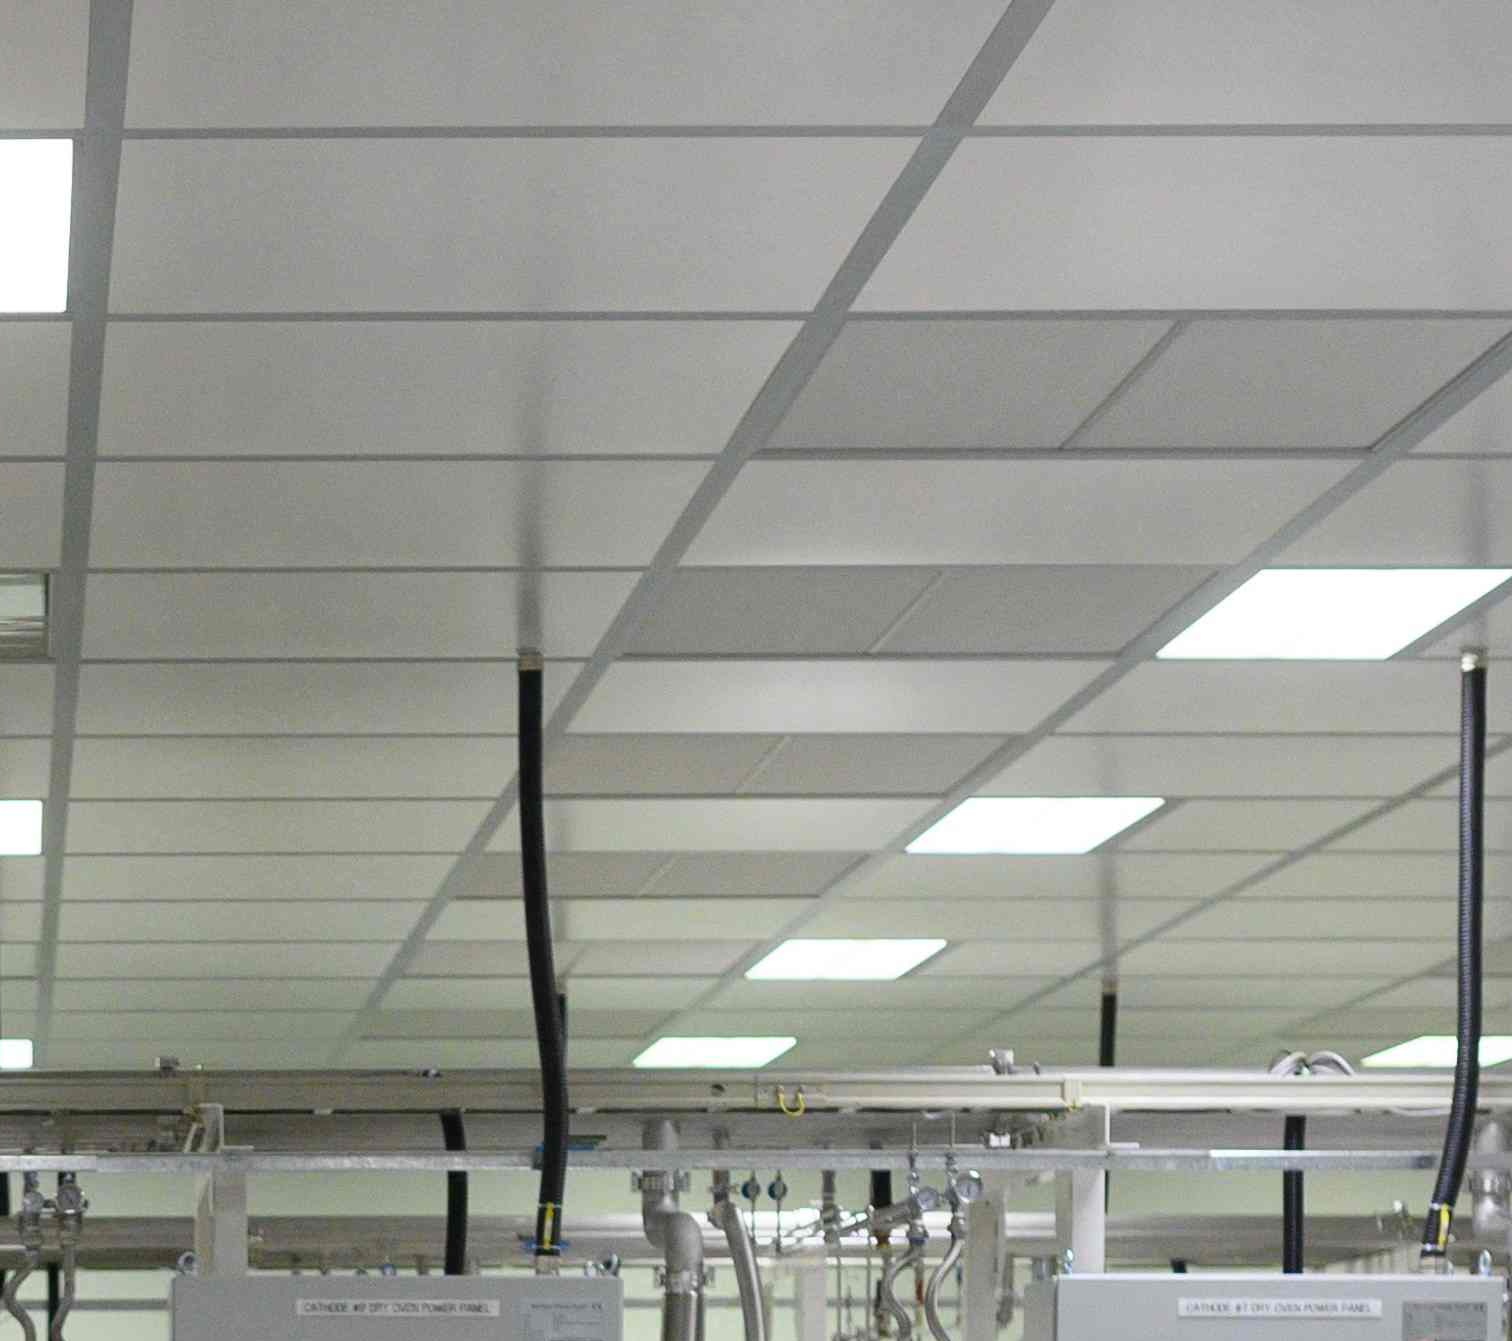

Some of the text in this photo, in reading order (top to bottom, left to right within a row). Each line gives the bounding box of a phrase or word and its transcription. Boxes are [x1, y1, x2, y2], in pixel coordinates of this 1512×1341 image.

[303, 1302, 348, 1313] CATHODE
[369, 1302, 389, 1313] DRY
[393, 1302, 420, 1313] OVEN
[422, 1302, 457, 1313] POWER
[459, 1302, 490, 1313] PANEL
[1186, 1303, 1229, 1313] CATHODE
[1274, 1303, 1301, 1313] OVEN
[1303, 1303, 1338, 1313] POWER
[1341, 1303, 1371, 1313] PANEL
